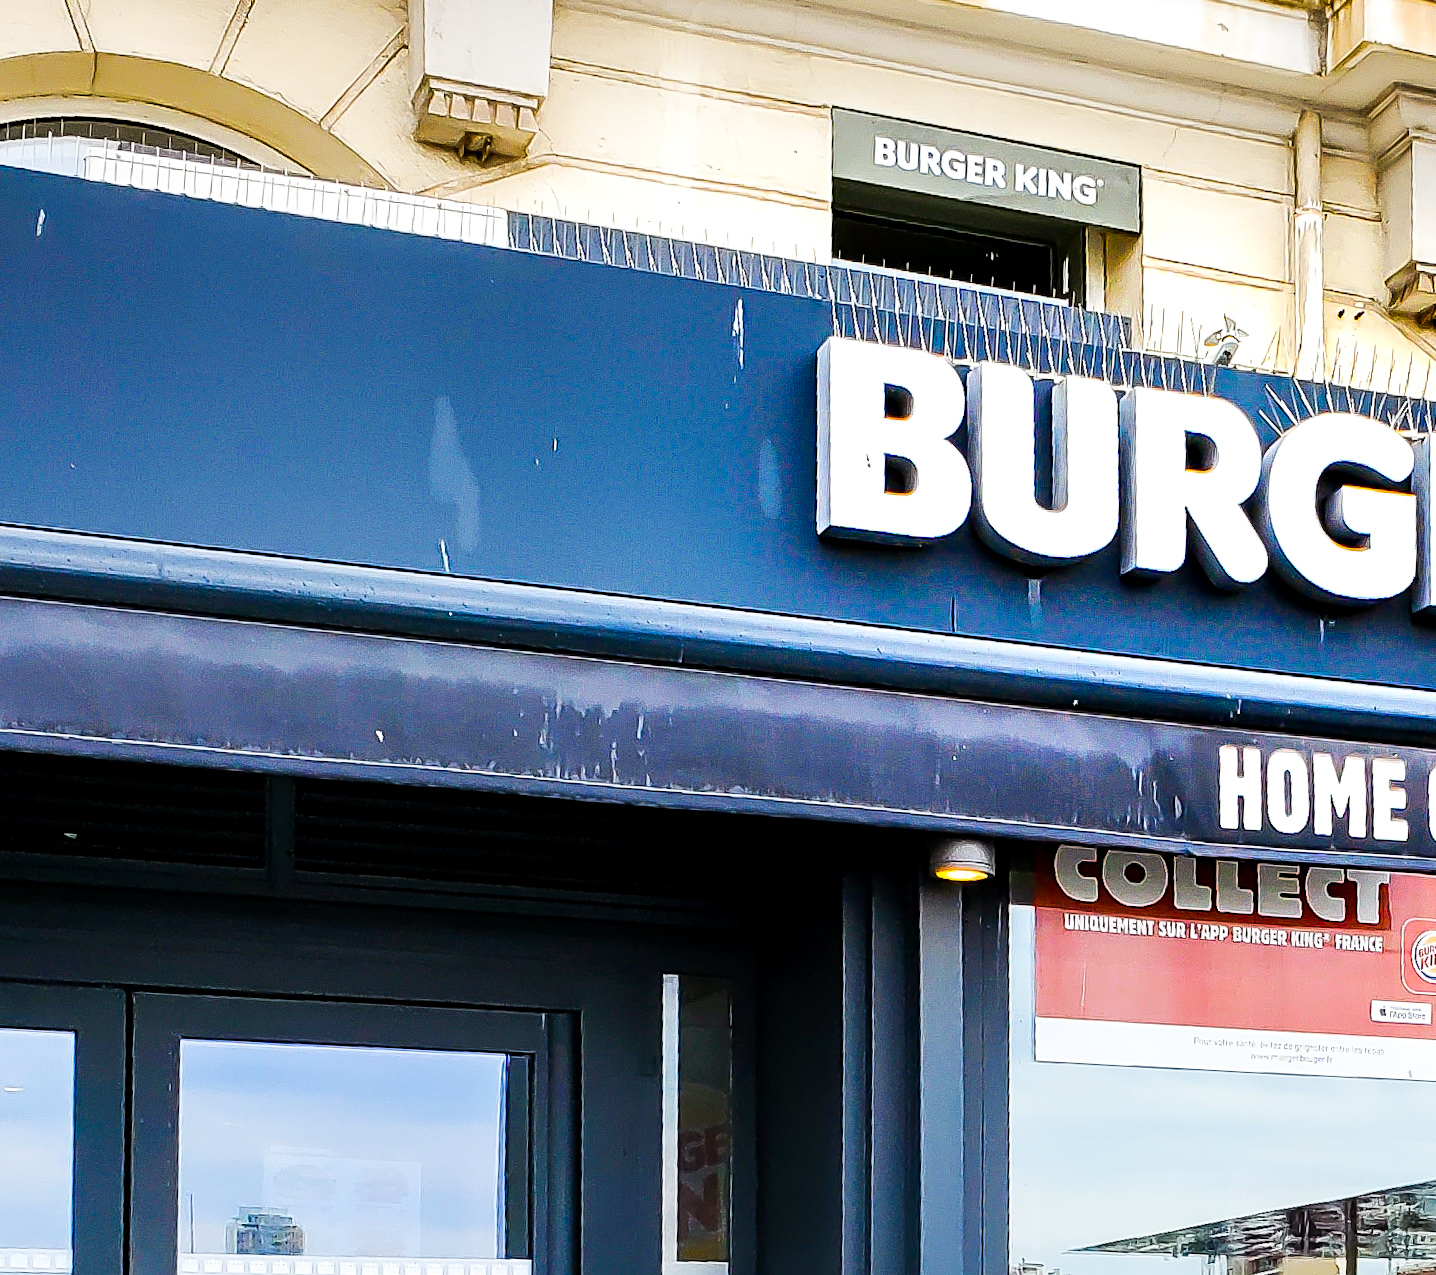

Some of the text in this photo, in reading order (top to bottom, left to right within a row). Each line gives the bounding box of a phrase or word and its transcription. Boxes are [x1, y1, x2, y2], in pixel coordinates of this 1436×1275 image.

[873, 135, 1007, 190] BURGER
[1218, 744, 1410, 843] HOME
[1053, 844, 1390, 924] COLLECT
[1063, 912, 1155, 937] UNIQUEMENT
[1158, 920, 1187, 939] SUR
[1189, 923, 1229, 943] L'APP
[1232, 926, 1288, 947] BURGER
[1334, 935, 1384, 953] FRANCE
